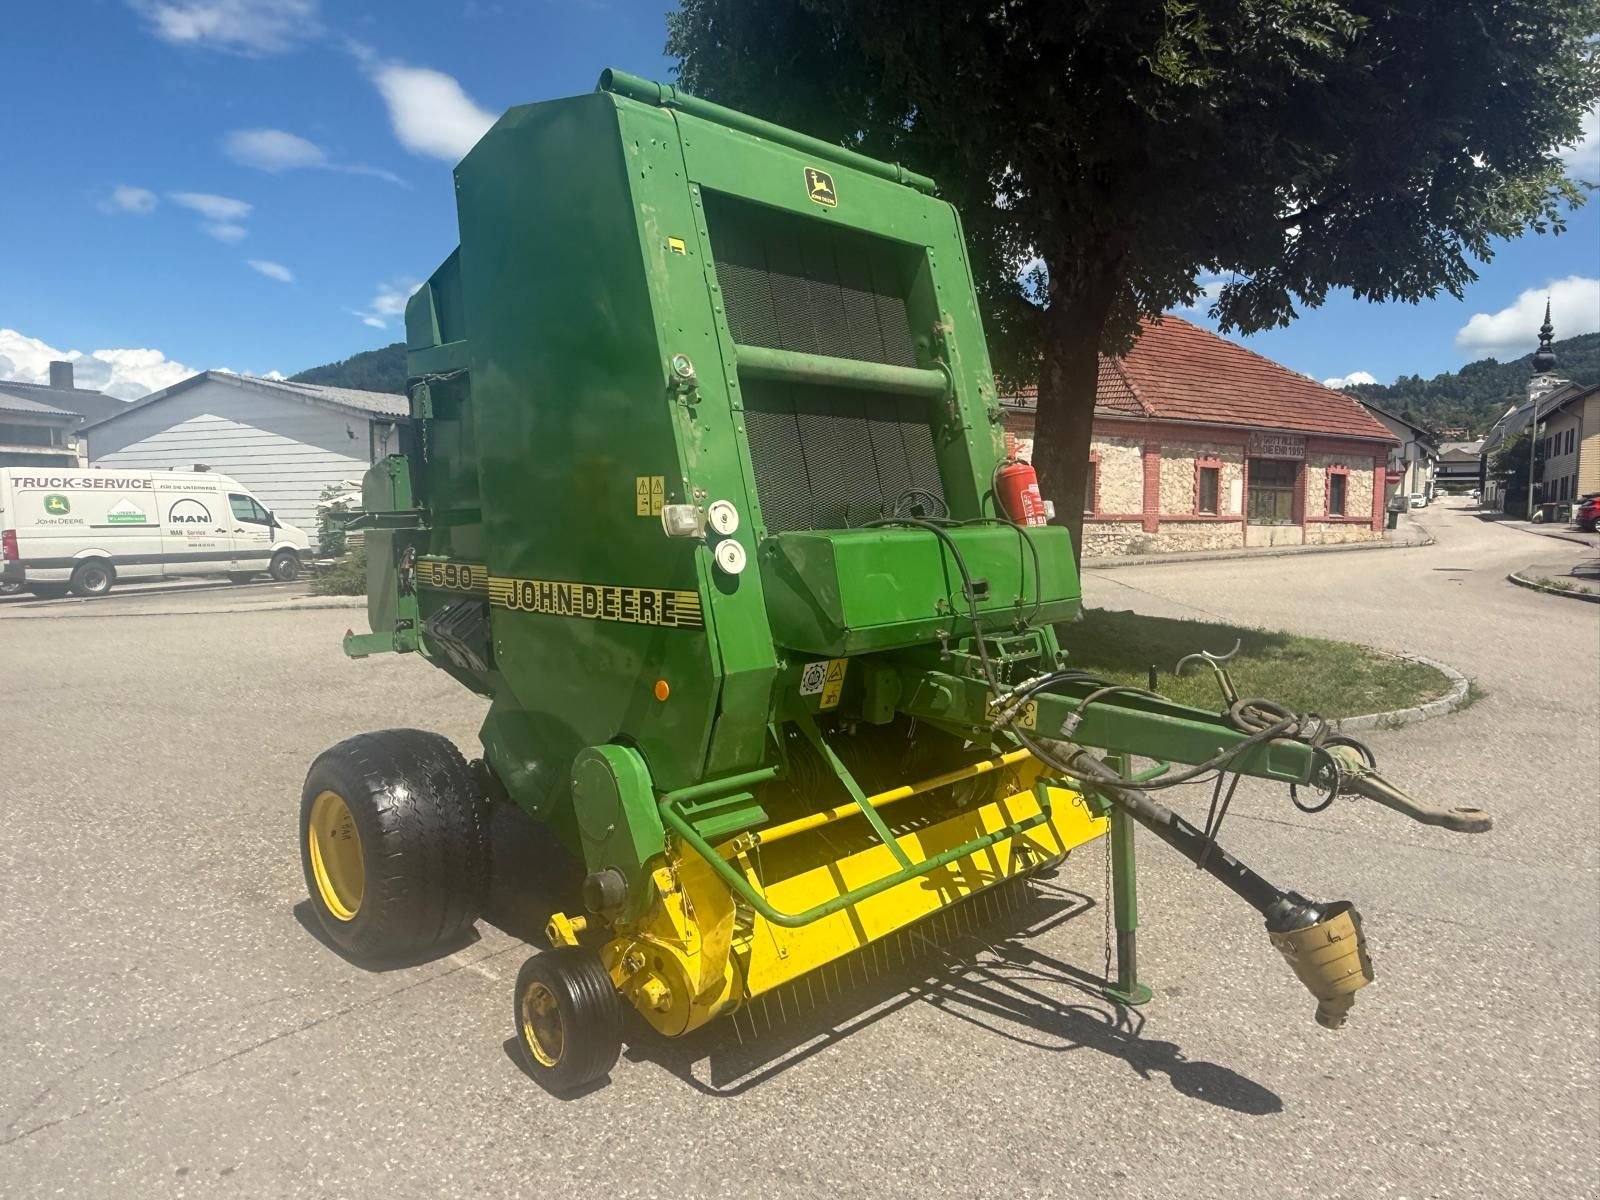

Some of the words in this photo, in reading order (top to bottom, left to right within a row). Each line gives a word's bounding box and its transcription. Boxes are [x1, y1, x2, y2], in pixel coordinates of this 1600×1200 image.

[10, 477, 152, 489] TRUCK-SERVICE
[172, 515, 209, 523] MAN
[432, 563, 473, 589] 590
[506, 580, 573, 615] JOHN
[581, 586, 678, 626] DEERE
